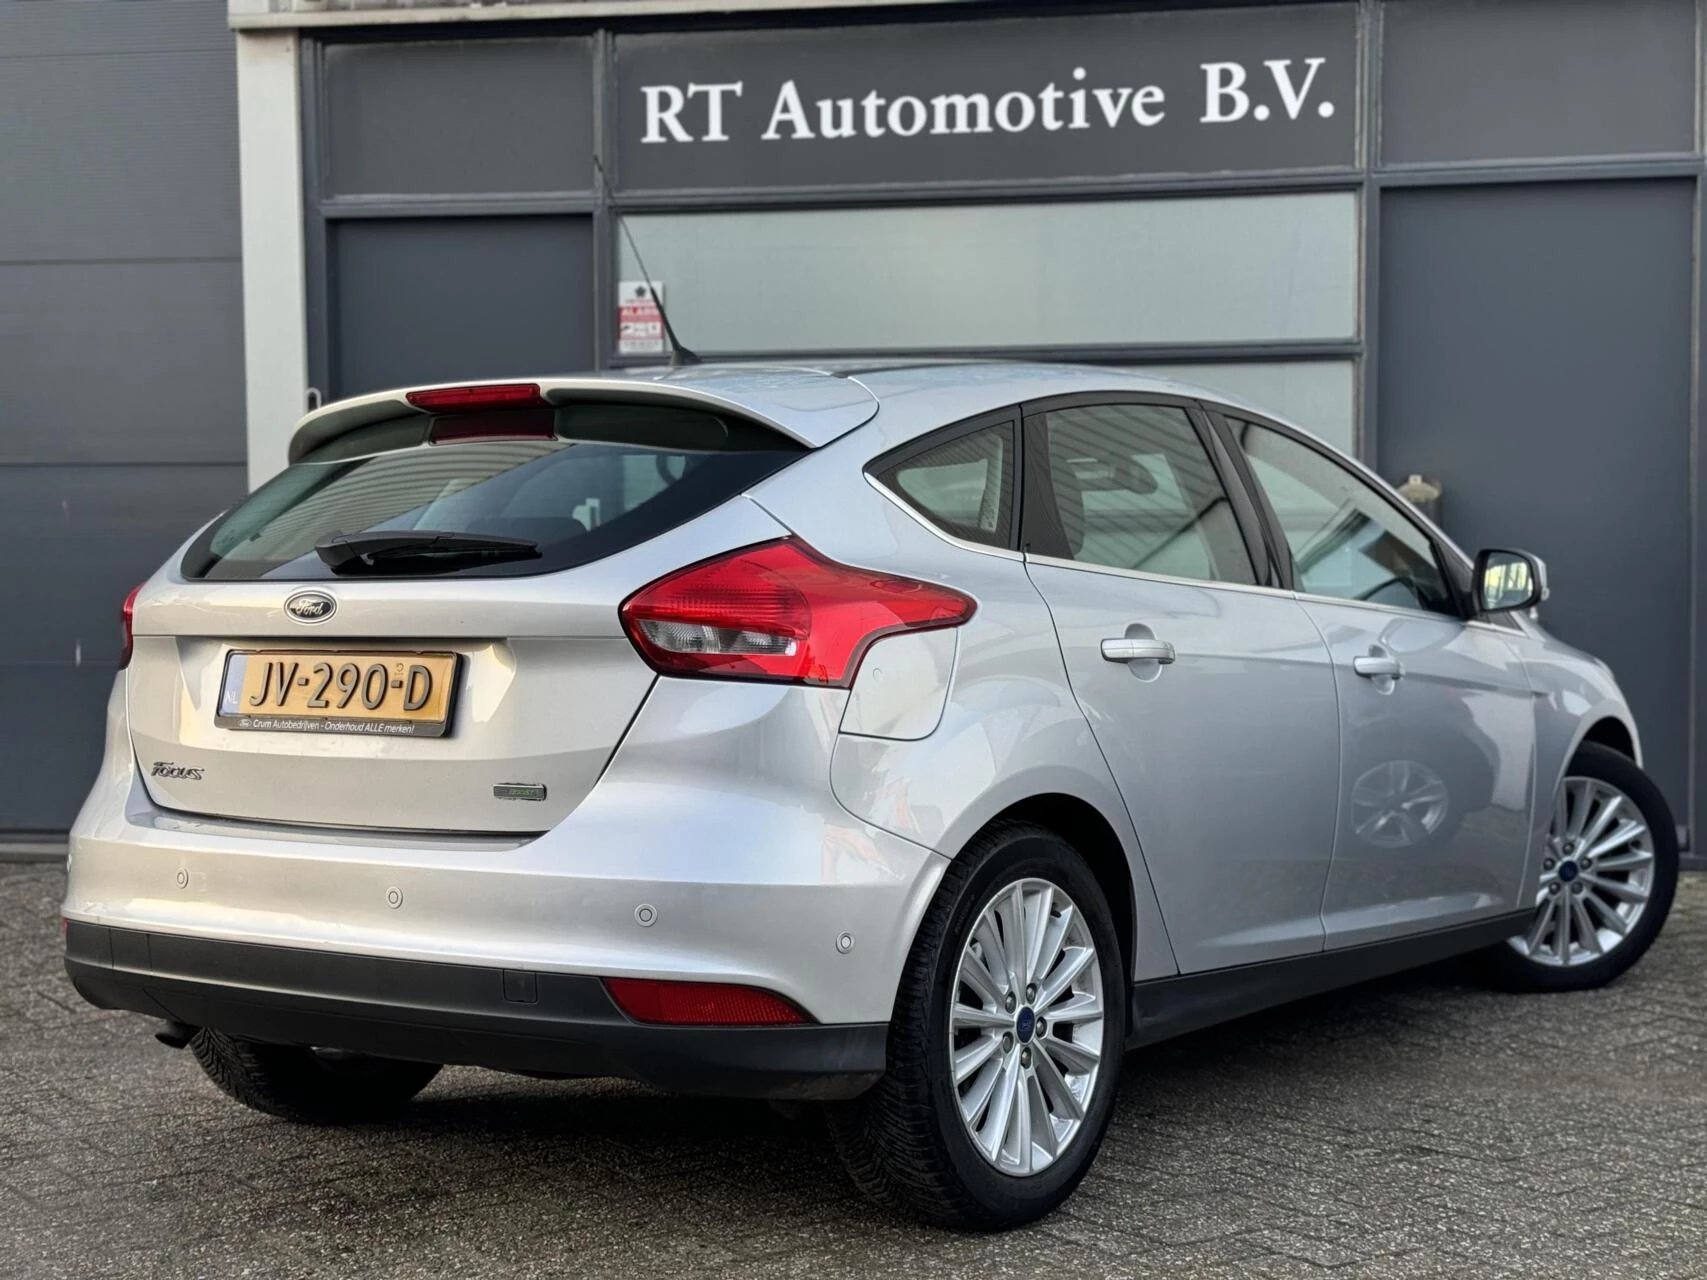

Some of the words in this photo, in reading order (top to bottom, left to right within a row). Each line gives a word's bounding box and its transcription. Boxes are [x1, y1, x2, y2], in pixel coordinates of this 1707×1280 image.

[640, 81, 743, 143] RT
[761, 67, 1166, 141] Automotive
[1200, 57, 1336, 123] B.V.
[296, 598, 325, 616] Ford
[250, 661, 433, 711] JV-290-D
[252, 718, 272, 729] Crum
[272, 720, 319, 731] Autobedrijven
[324, 721, 364, 733] Onderhoud
[364, 722, 385, 733] ALLE
[151, 761, 205, 780] Focus
